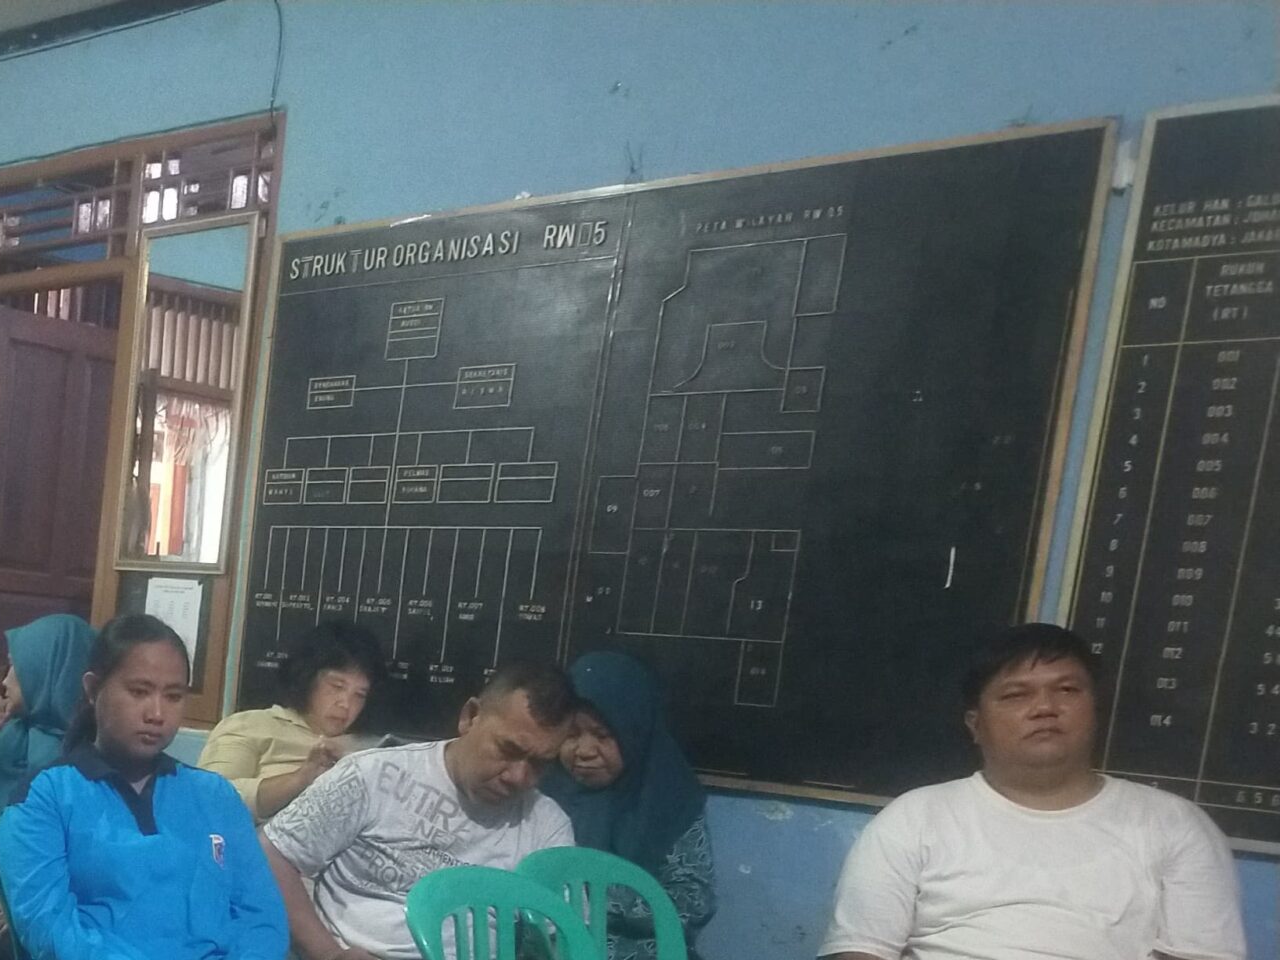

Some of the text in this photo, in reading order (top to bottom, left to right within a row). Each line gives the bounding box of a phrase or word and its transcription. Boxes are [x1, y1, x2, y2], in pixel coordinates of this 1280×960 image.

[1151, 214, 1232, 233] KECAMATAN
[392, 230, 520, 268] ORGANISASI
[1147, 233, 1226, 251] KOTAMADYA
[1205, 281, 1274, 297] TETANGGA
[1149, 296, 1167, 309] NO
[750, 599, 763, 611] 13
